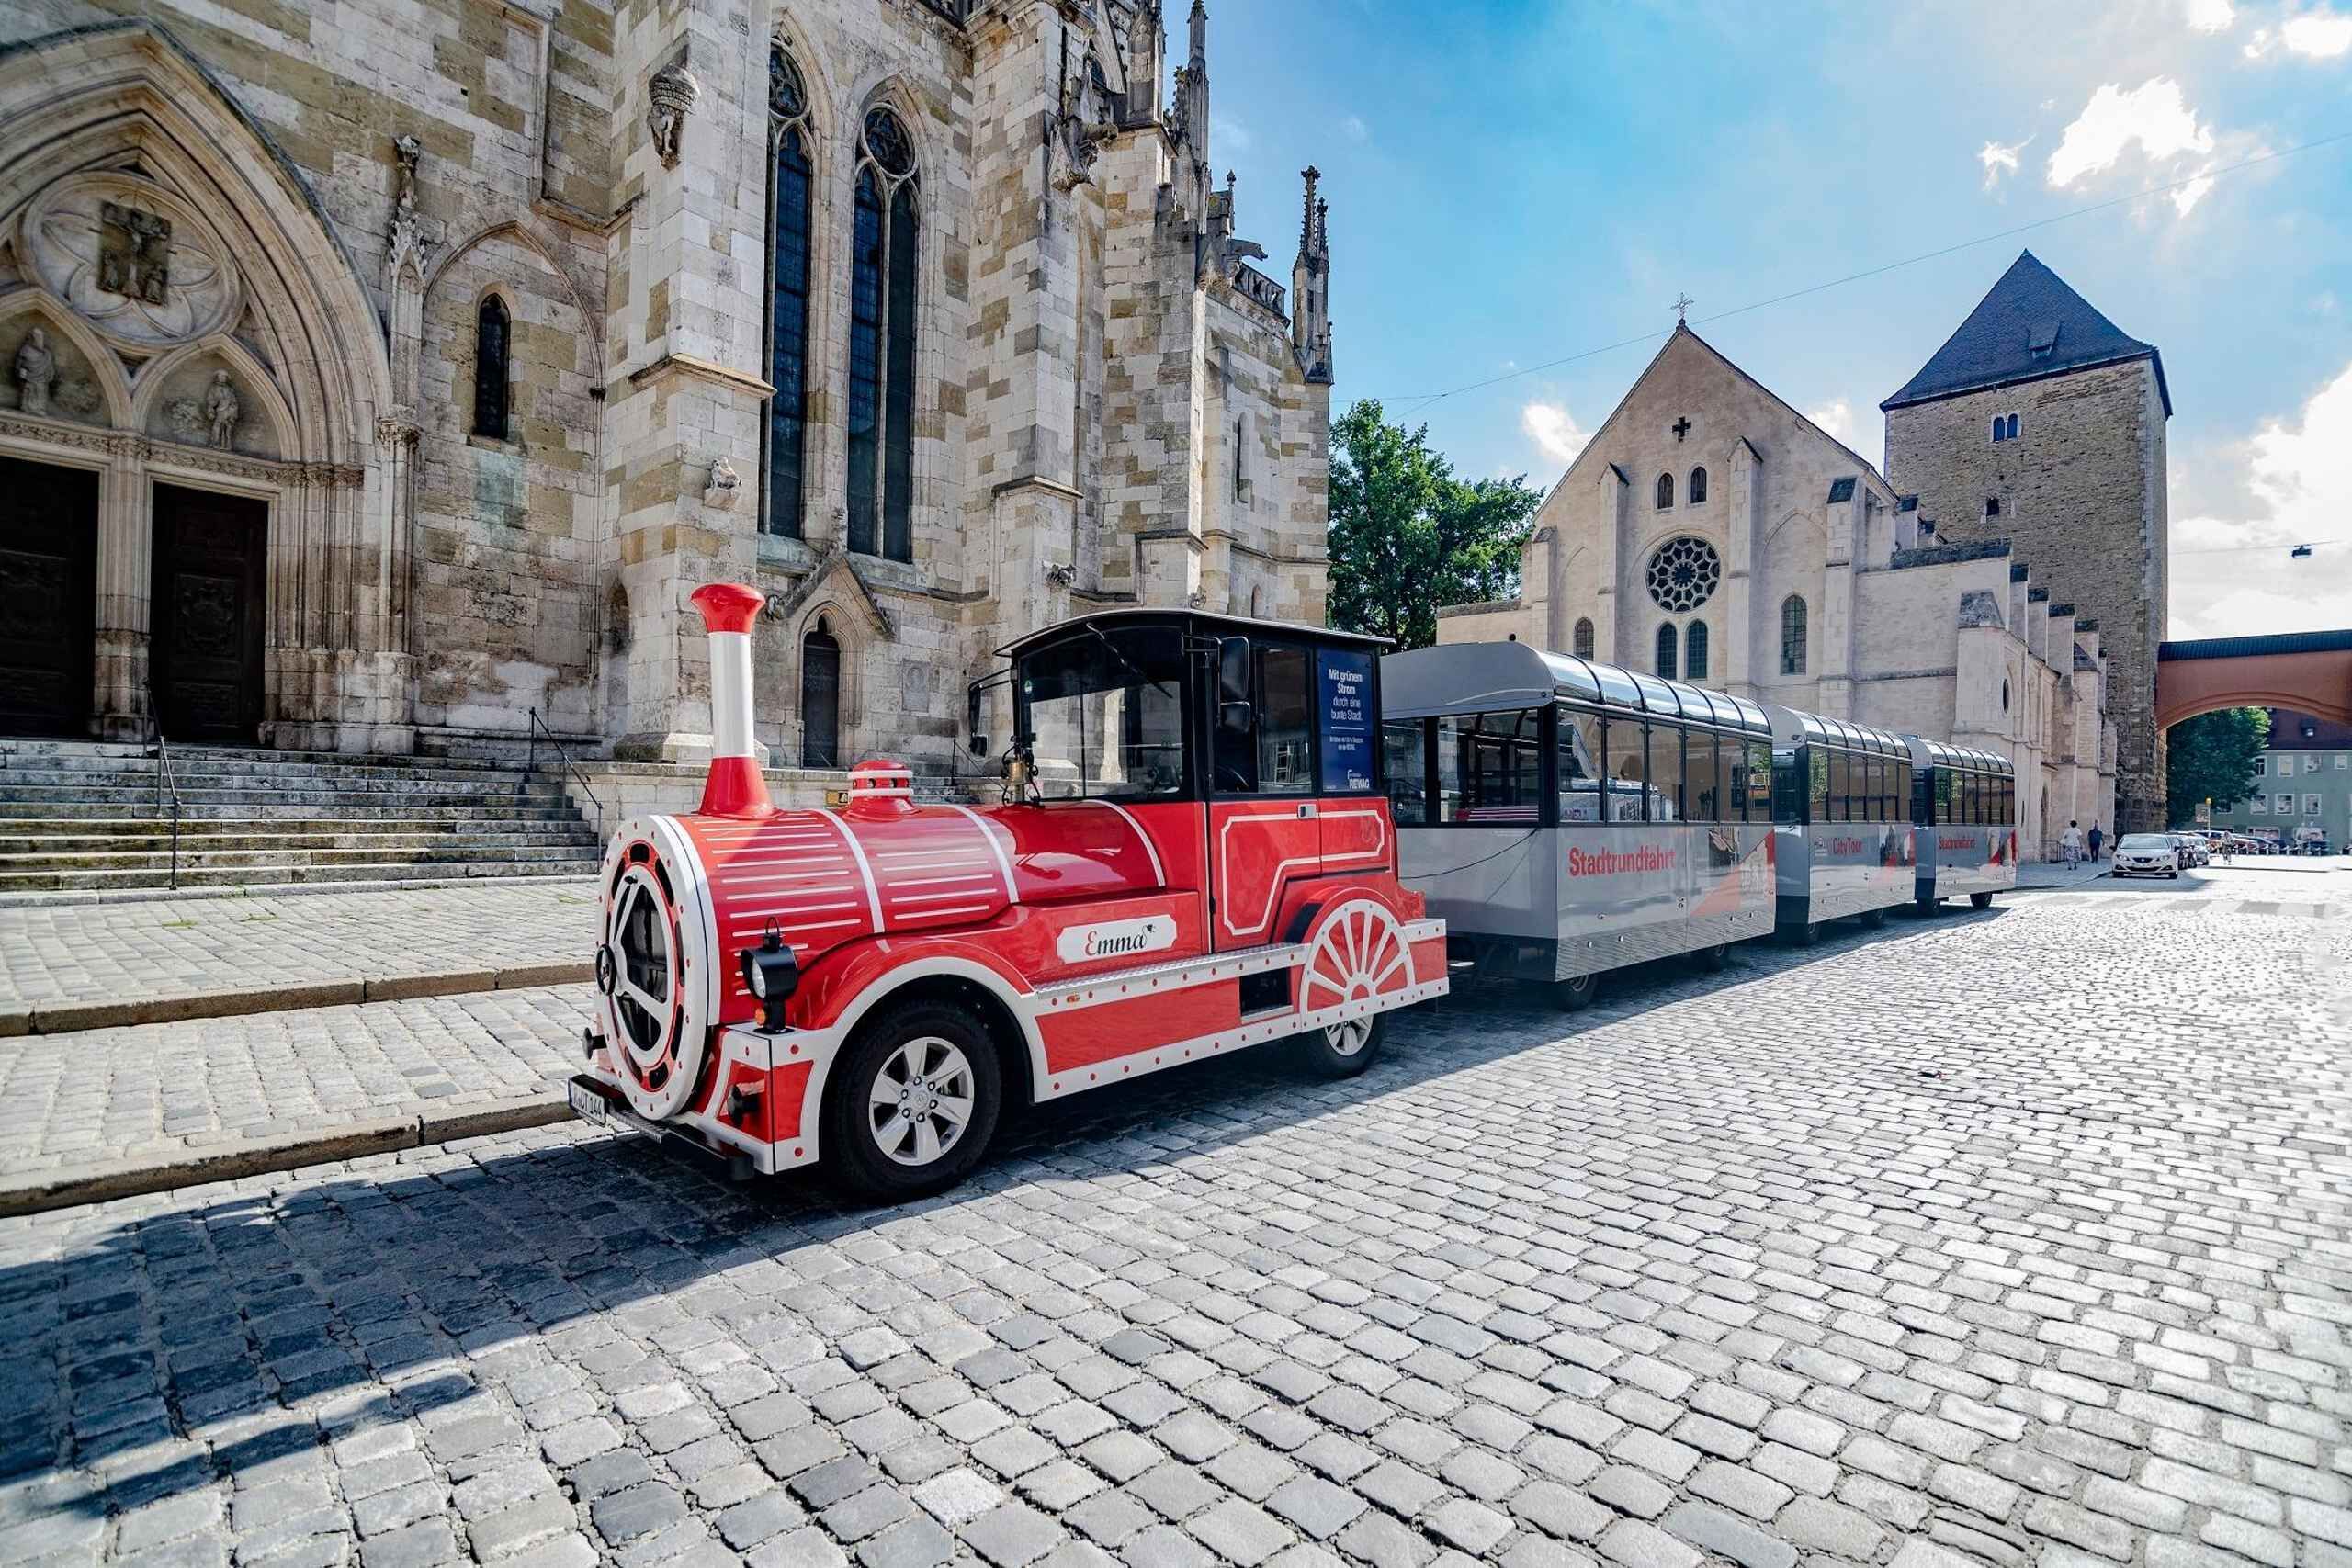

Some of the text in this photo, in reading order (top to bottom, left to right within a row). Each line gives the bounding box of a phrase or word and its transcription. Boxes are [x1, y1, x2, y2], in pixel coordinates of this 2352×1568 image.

[1329, 668, 1363, 682] Mit grünem
[1337, 682, 1356, 694] Strom
[1333, 696, 1362, 708] durch eine
[1330, 708, 1347, 720] bunte
[1349, 778, 1370, 790] REWAG
[1568, 844, 1677, 877] Stadtrundfahrt
[1085, 928, 1148, 956] Emma
